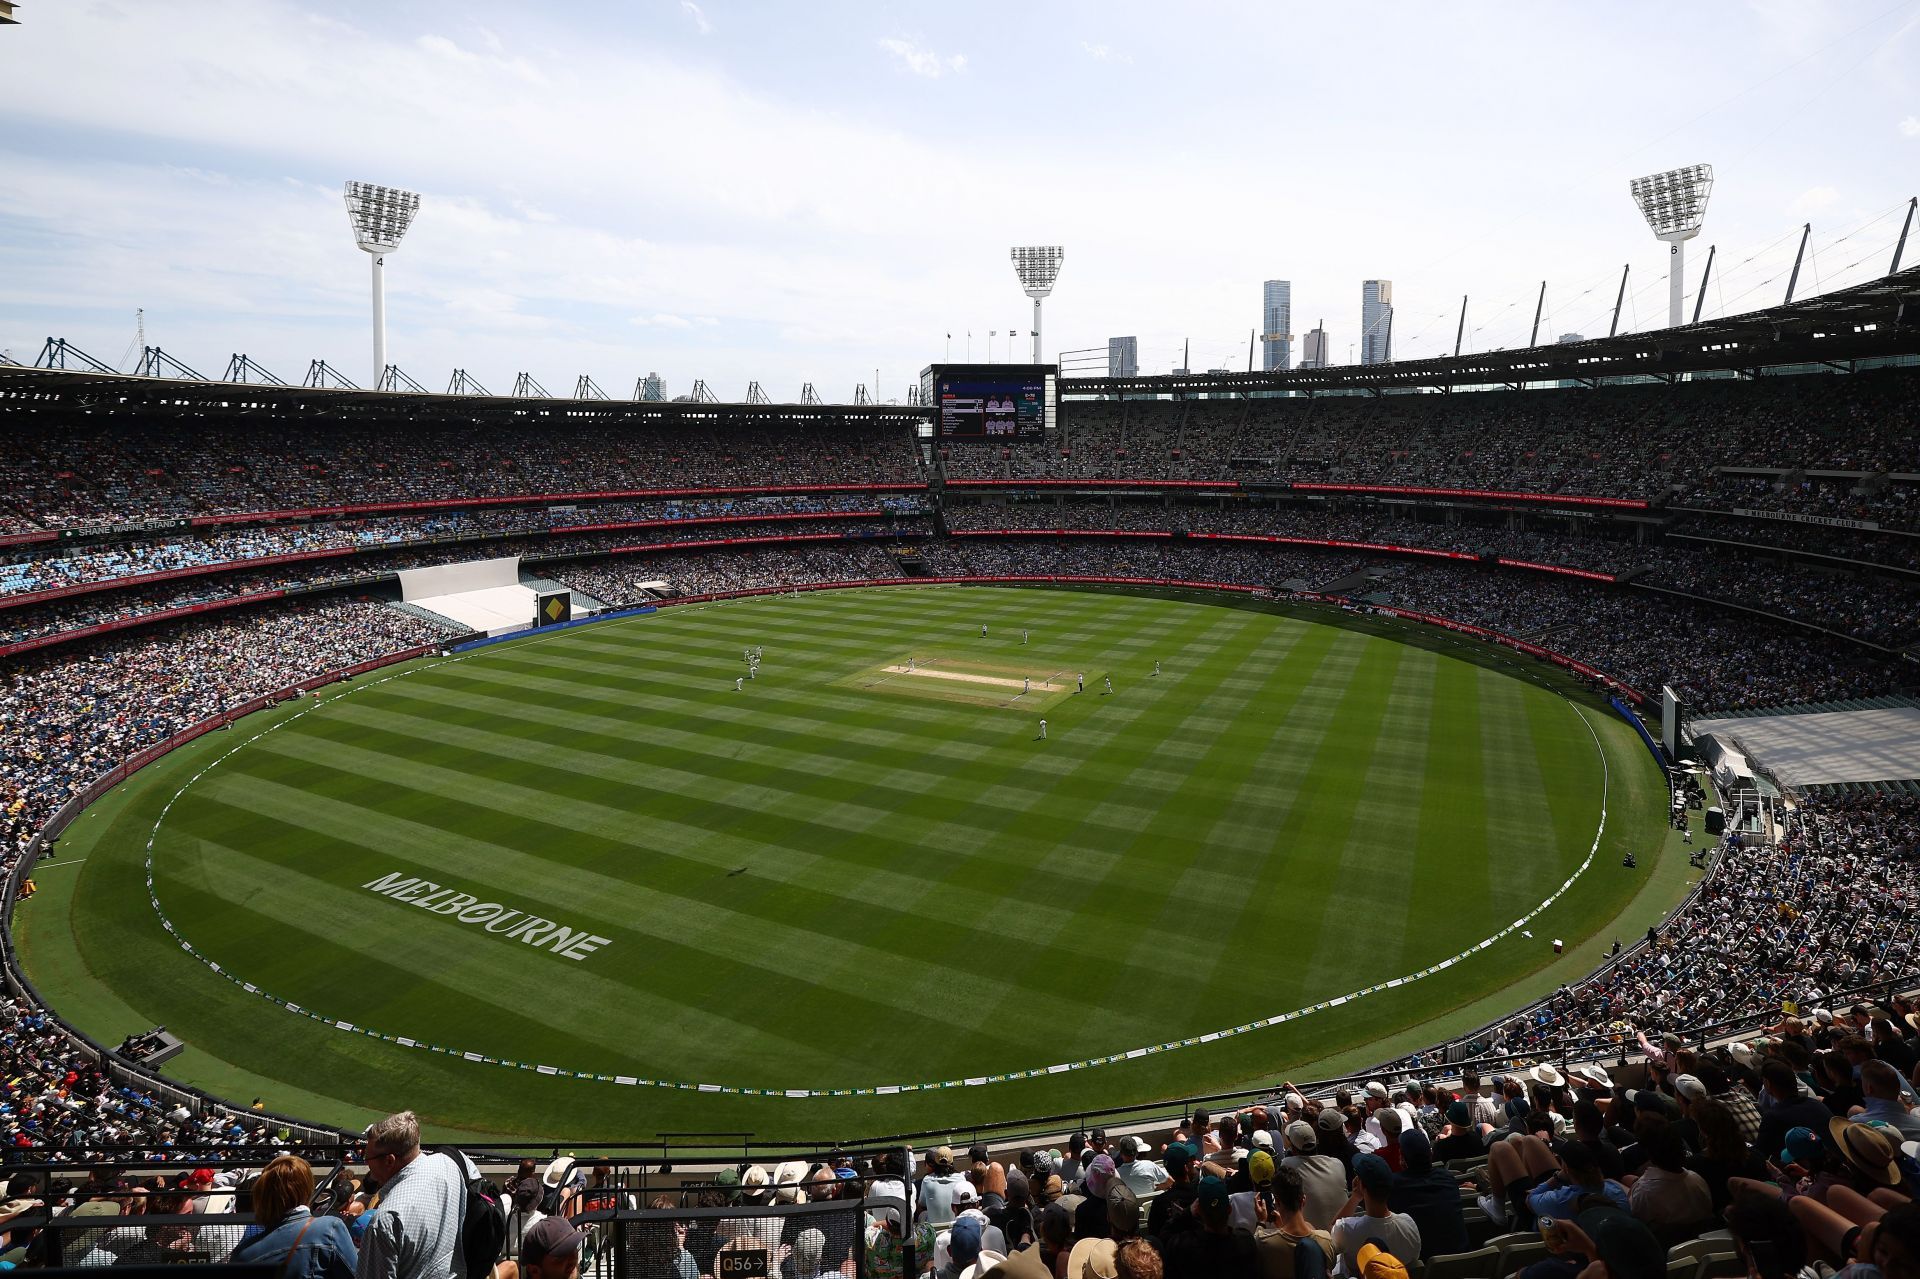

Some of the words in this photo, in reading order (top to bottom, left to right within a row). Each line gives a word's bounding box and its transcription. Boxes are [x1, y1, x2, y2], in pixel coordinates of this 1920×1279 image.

[1671, 246, 1677, 254] 6
[377, 258, 383, 267] 4
[1751, 510, 1797, 521] MELBOURNE
[1801, 515, 1832, 525] CRICKET
[1837, 519, 1856, 527] CLUB
[78, 527, 110, 537] SHANE
[113, 524, 144, 533] WARNE
[147, 521, 176, 529] STAND
[361, 872, 613, 961] MELBOURNE
[1071, 1061, 1087, 1069] bet365
[1091, 1057, 1107, 1065] bet365
[1111, 1053, 1126, 1061] bet365
[1009, 1071, 1026, 1079] bet365
[723, 1257, 752, 1271] Q56
